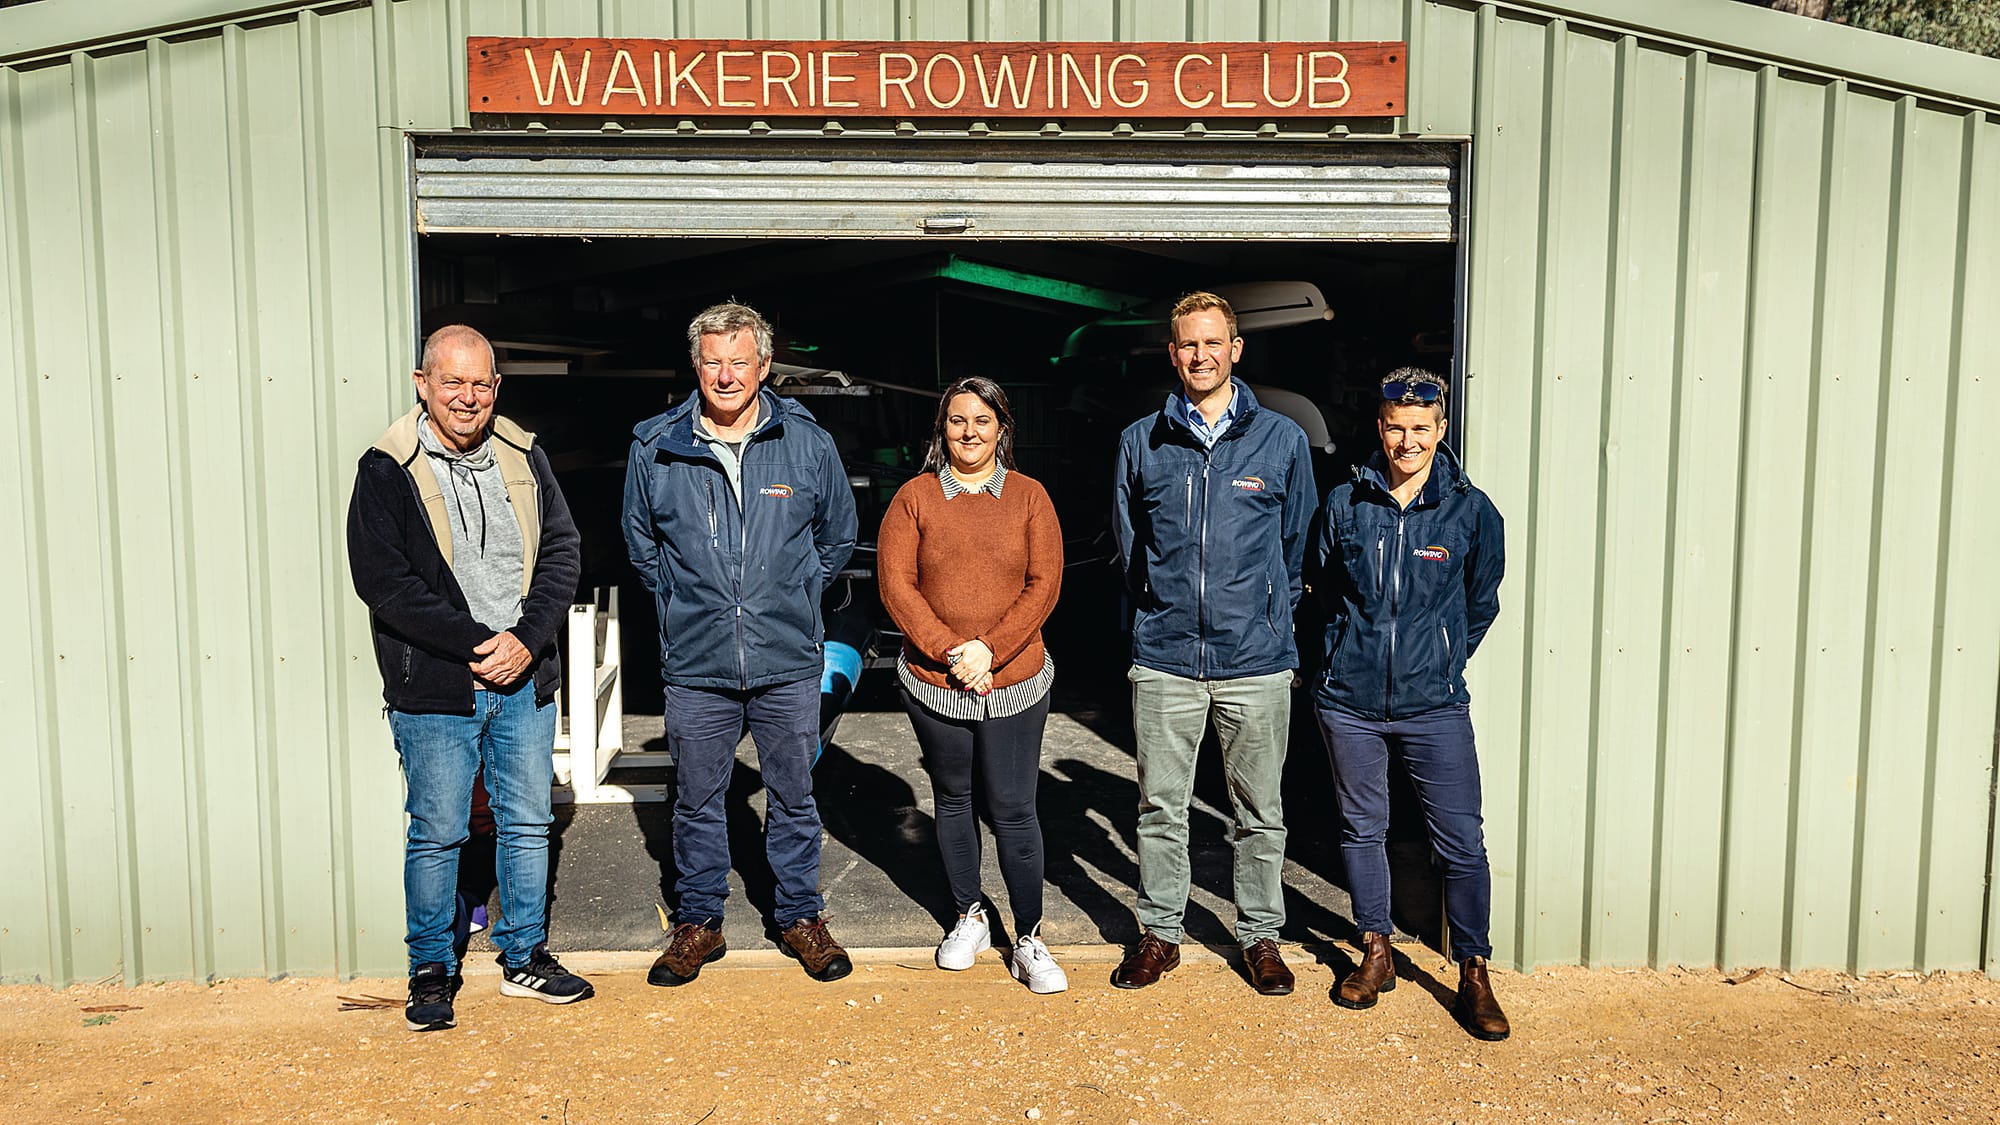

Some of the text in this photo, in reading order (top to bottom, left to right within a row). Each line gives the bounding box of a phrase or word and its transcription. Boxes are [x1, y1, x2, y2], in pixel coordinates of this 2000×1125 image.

[524, 48, 1351, 109] WAIKERIE ROWING CLUB
[1232, 480, 1260, 489] ROWING
[760, 487, 787, 495] ROWING
[1413, 549, 1443, 559] ROWING
